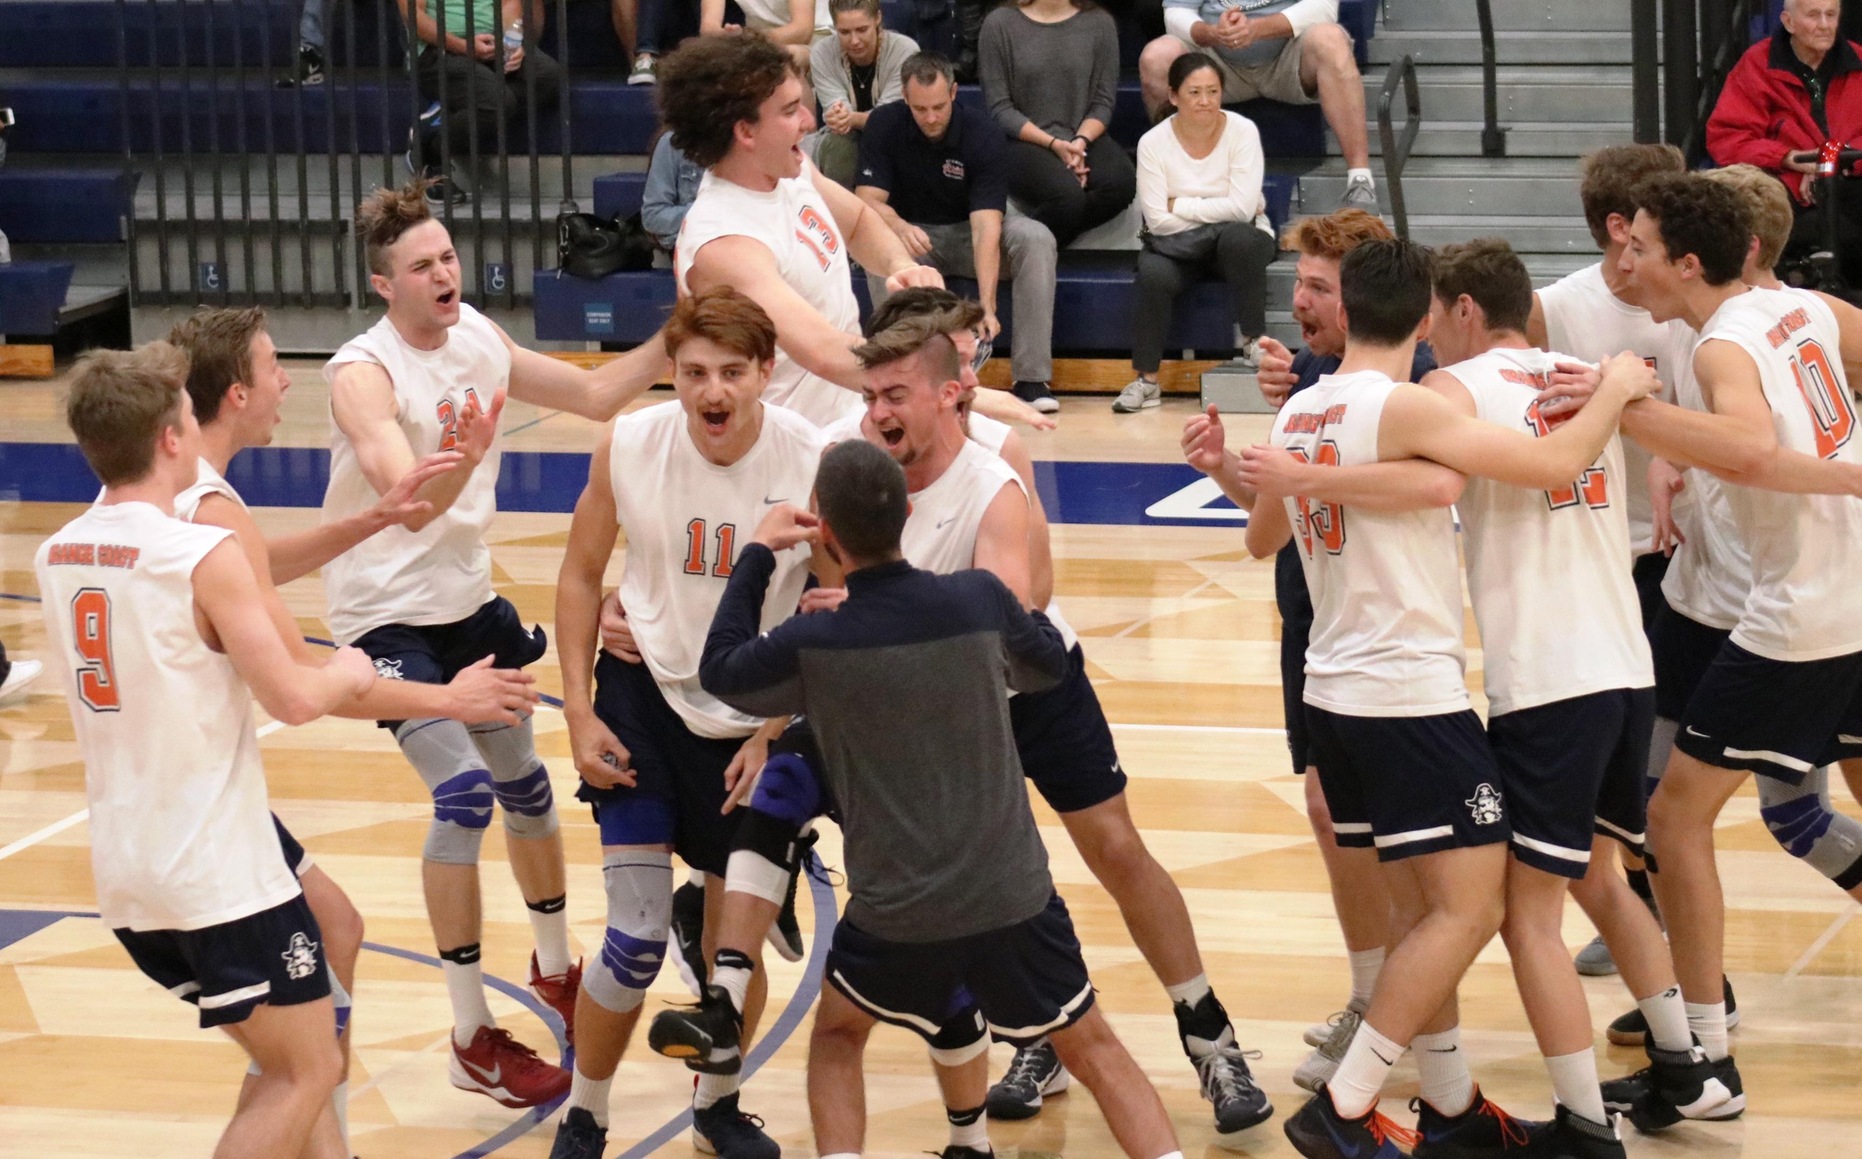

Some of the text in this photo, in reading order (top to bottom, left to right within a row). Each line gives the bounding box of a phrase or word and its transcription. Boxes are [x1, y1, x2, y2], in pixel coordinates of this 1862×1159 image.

[795, 204, 839, 273] 13
[1787, 337, 1856, 460] 10
[683, 517, 736, 578] 11
[71, 587, 121, 712] 9
